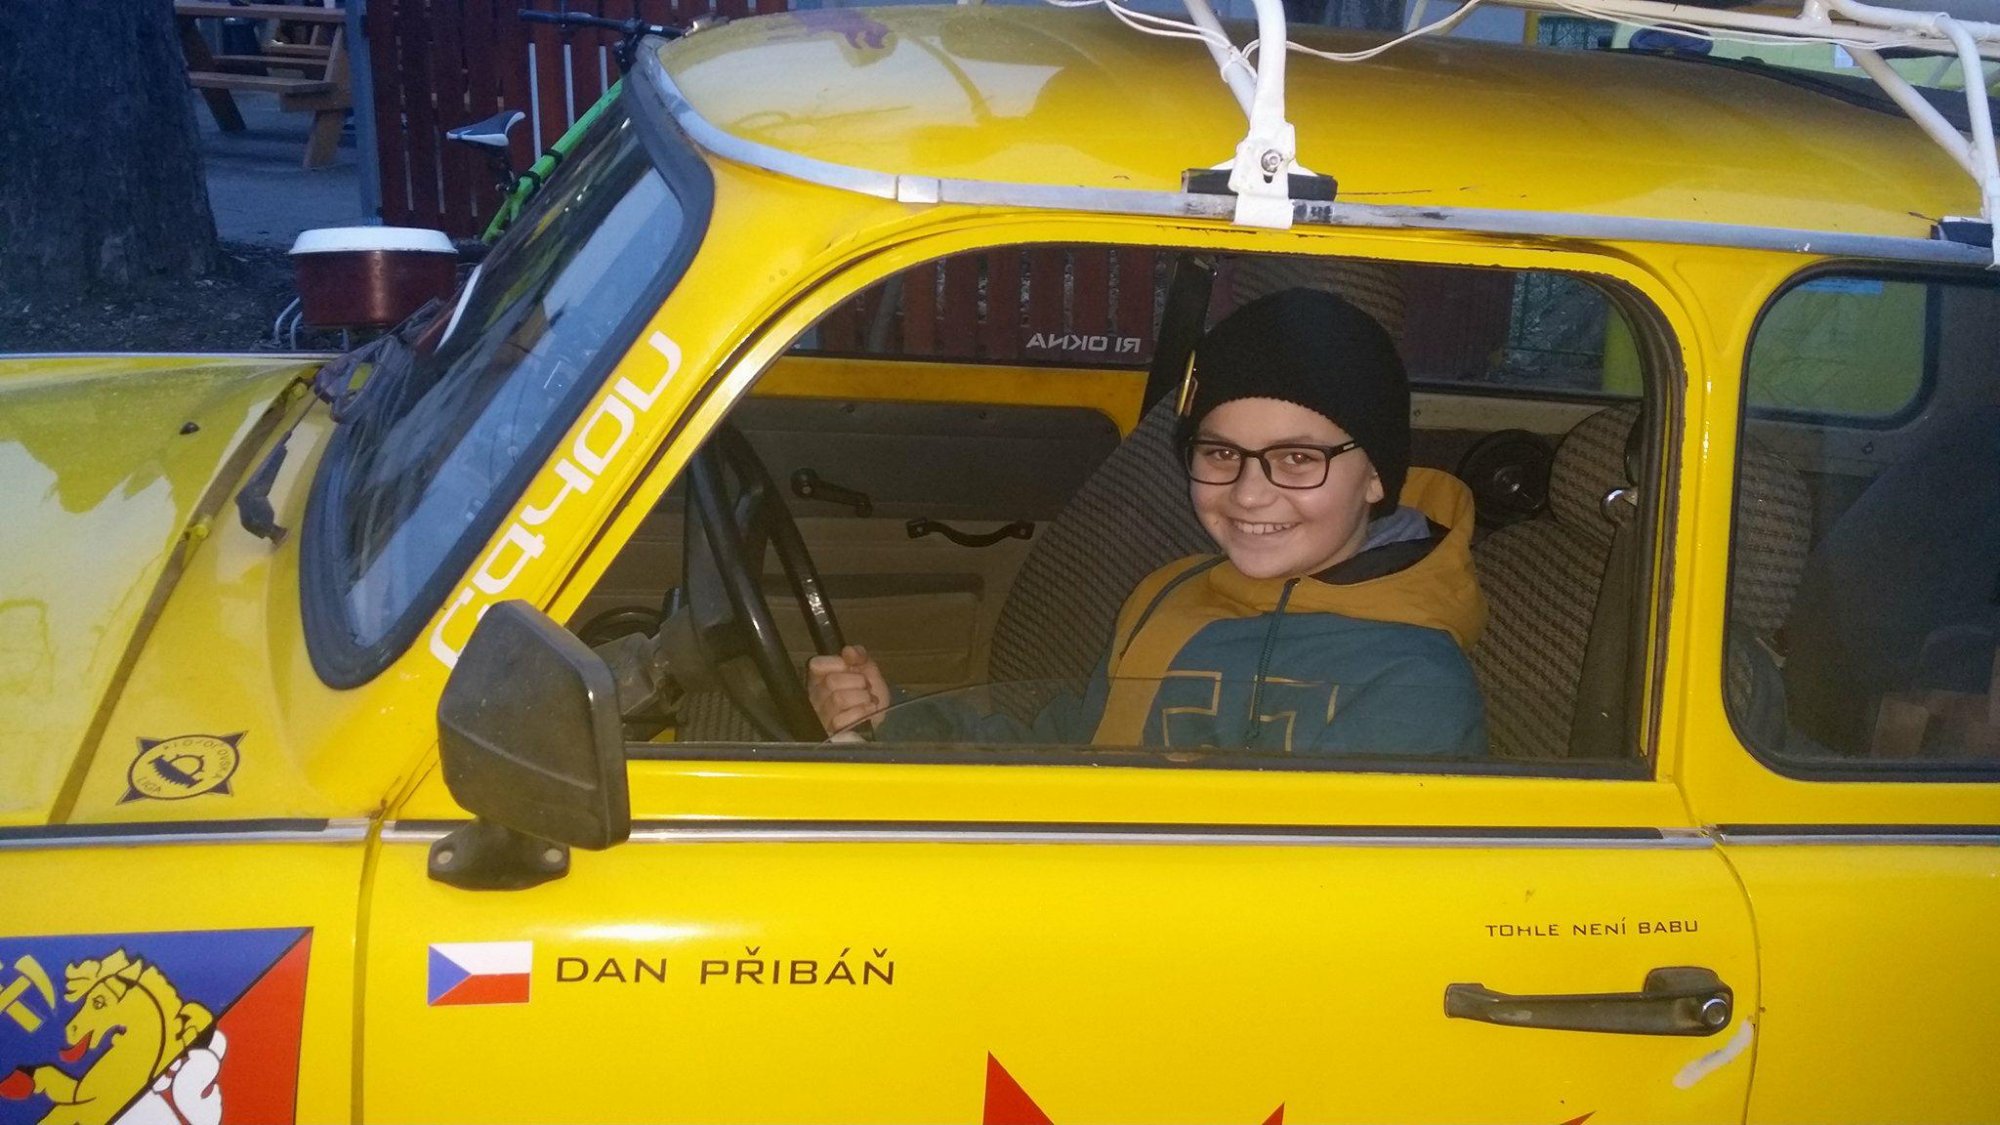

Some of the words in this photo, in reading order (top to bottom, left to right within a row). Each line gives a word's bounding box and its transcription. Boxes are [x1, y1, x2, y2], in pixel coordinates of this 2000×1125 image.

[1485, 923, 1560, 937] TOHLE
[1572, 917, 1627, 936] NENÍ
[1637, 919, 1699, 934] BABU
[556, 957, 668, 984] DAN
[700, 946, 895, 985] PŘIBÁŇ
